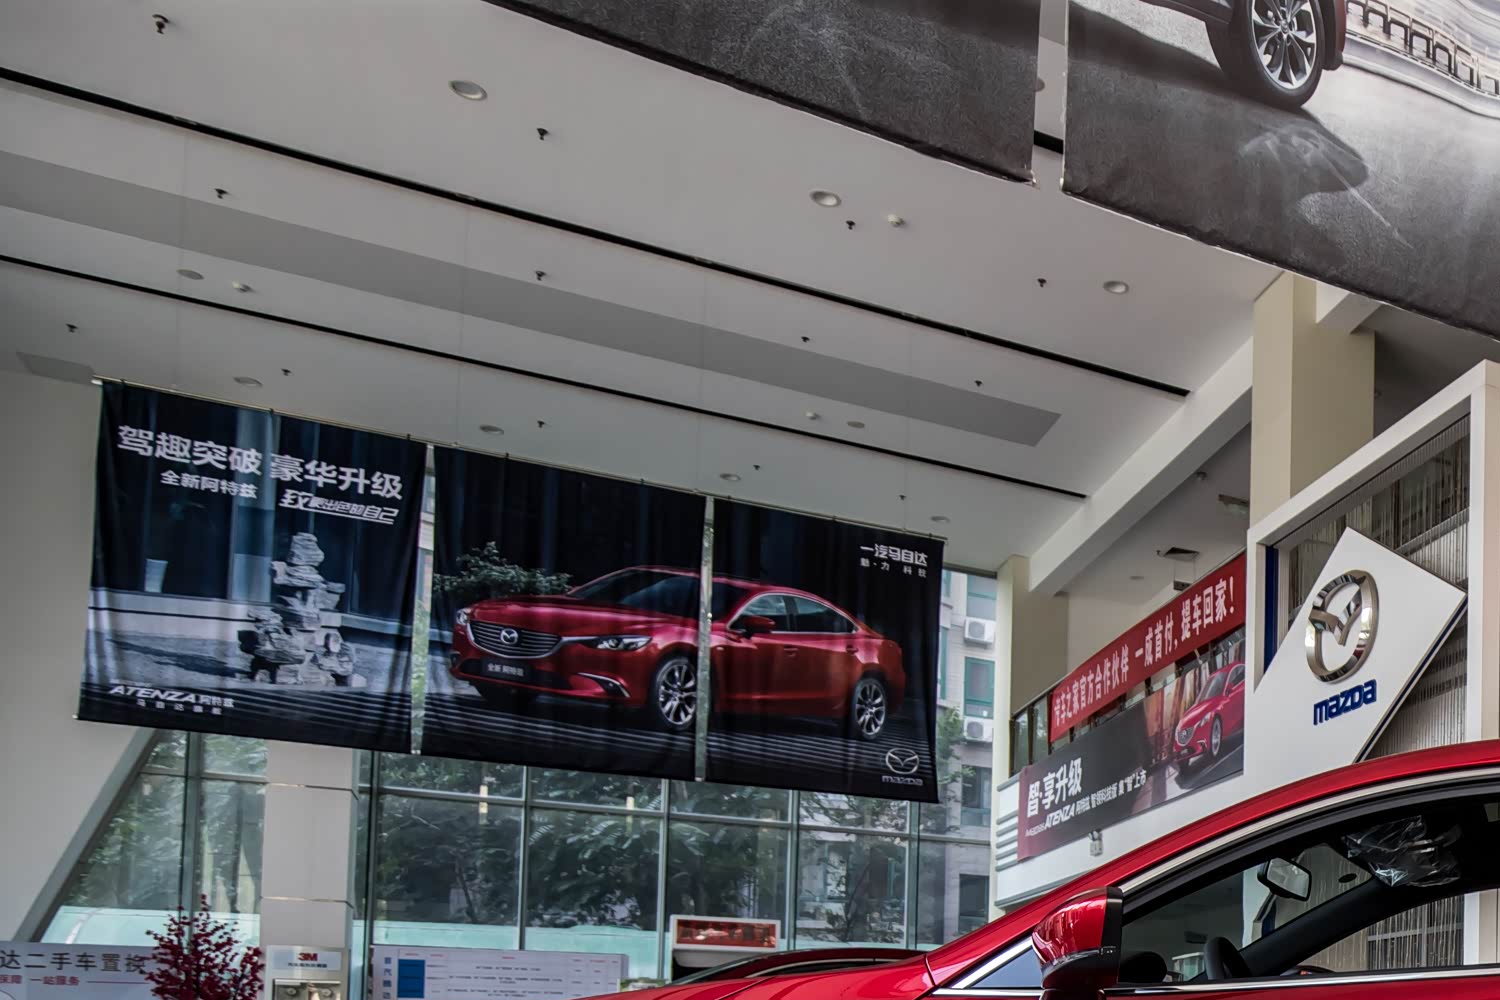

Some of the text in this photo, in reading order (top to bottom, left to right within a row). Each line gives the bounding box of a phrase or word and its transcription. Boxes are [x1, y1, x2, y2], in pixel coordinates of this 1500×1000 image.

[118, 425, 403, 500] 驾趣突破 豪华升级
[161, 470, 258, 499] 全新阿特兹
[860, 543, 928, 566] 一汽马自达
[109, 685, 196, 703] ATENZA
[1313, 679, 1378, 726] mazda
[1045, 803, 1076, 829] ATENZA
[298, 952, 318, 961] 3M
